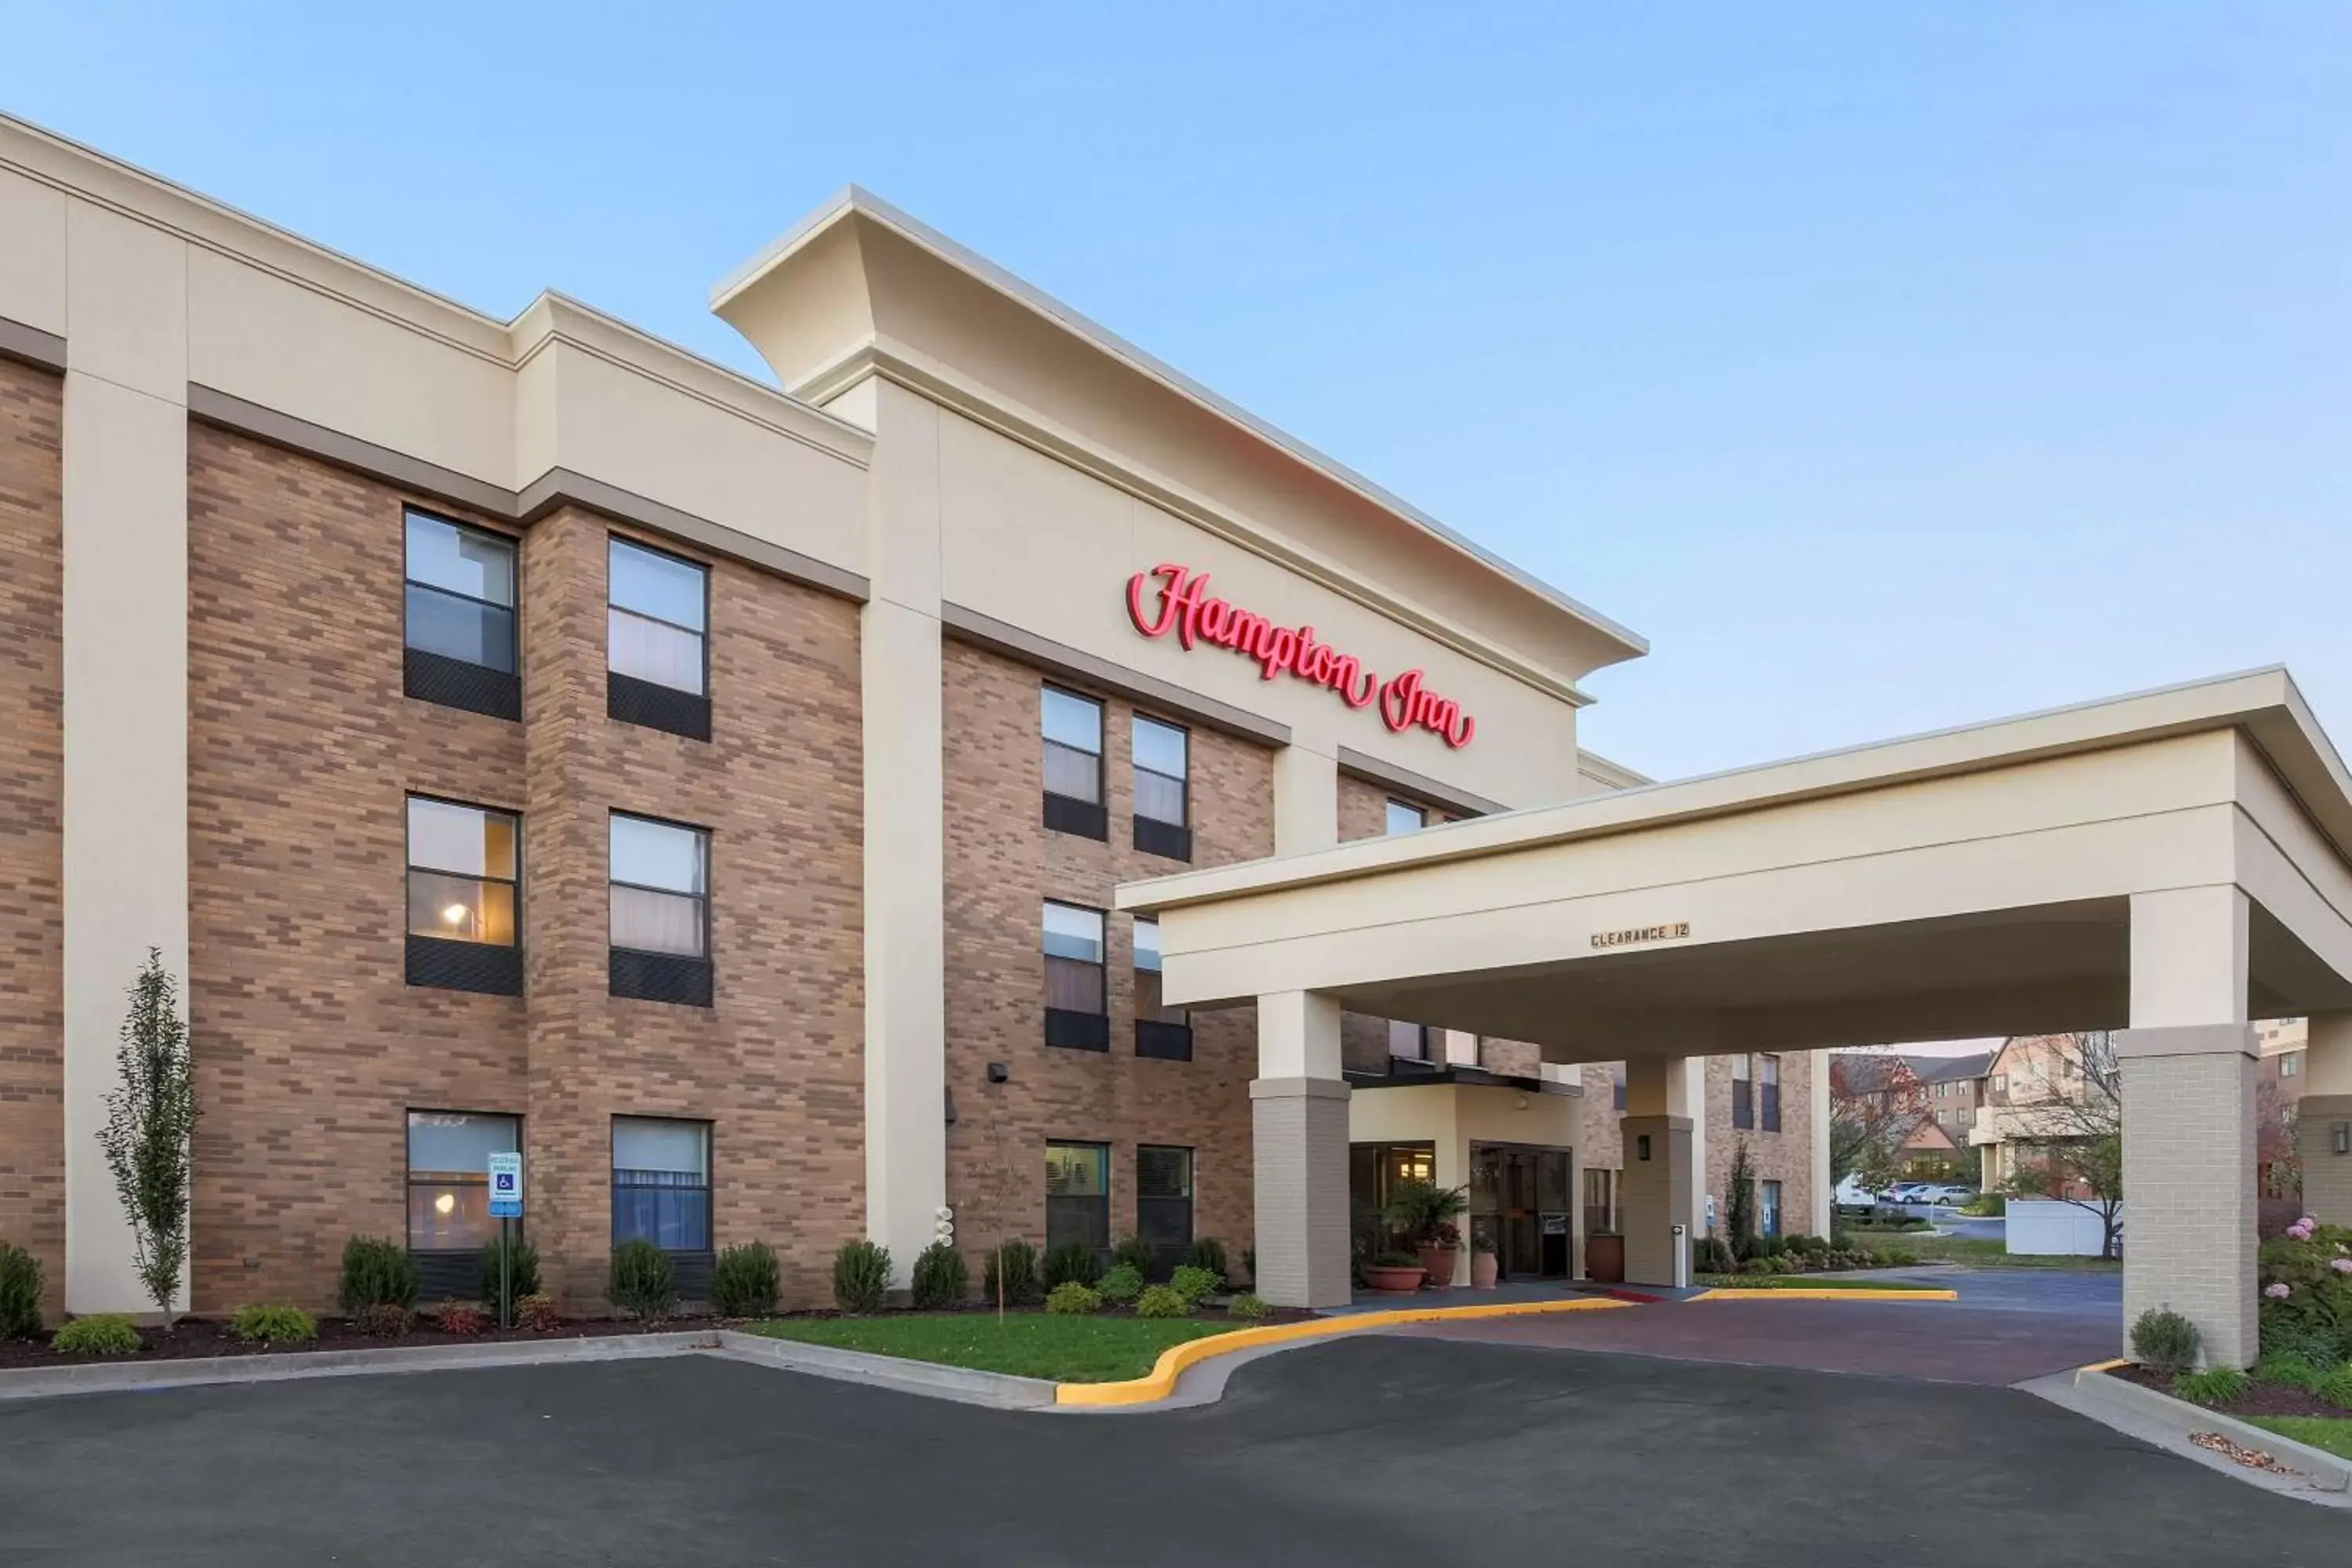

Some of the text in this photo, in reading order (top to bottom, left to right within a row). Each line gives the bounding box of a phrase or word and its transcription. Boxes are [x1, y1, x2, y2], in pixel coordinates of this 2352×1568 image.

[1126, 564, 1475, 750] Hampton Inn
[1591, 926, 1666, 946] CLEARANCE
